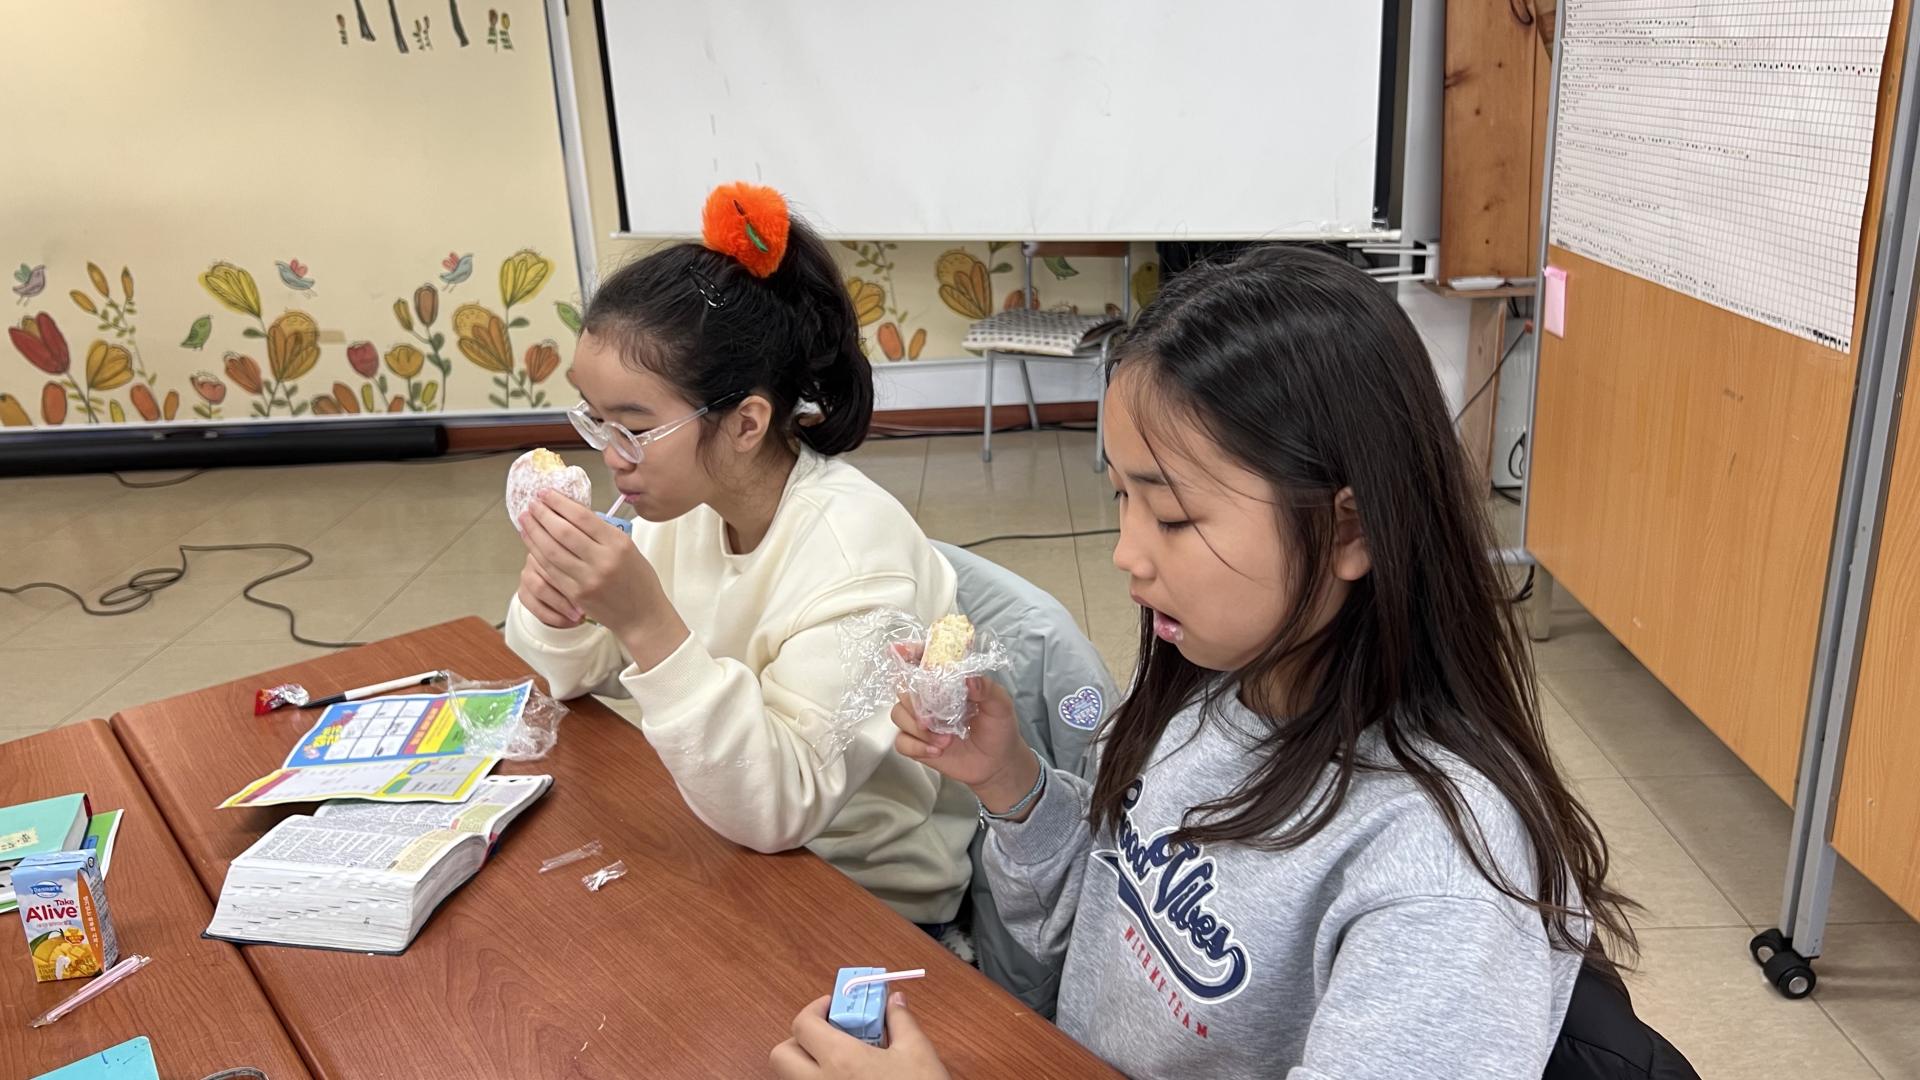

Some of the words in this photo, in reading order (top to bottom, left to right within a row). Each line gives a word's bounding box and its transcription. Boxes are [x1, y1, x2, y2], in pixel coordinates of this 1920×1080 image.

[54, 898, 75, 906] Take
[1124, 925, 1152, 969] WITH
[1168, 991, 1209, 1039] TEAM
